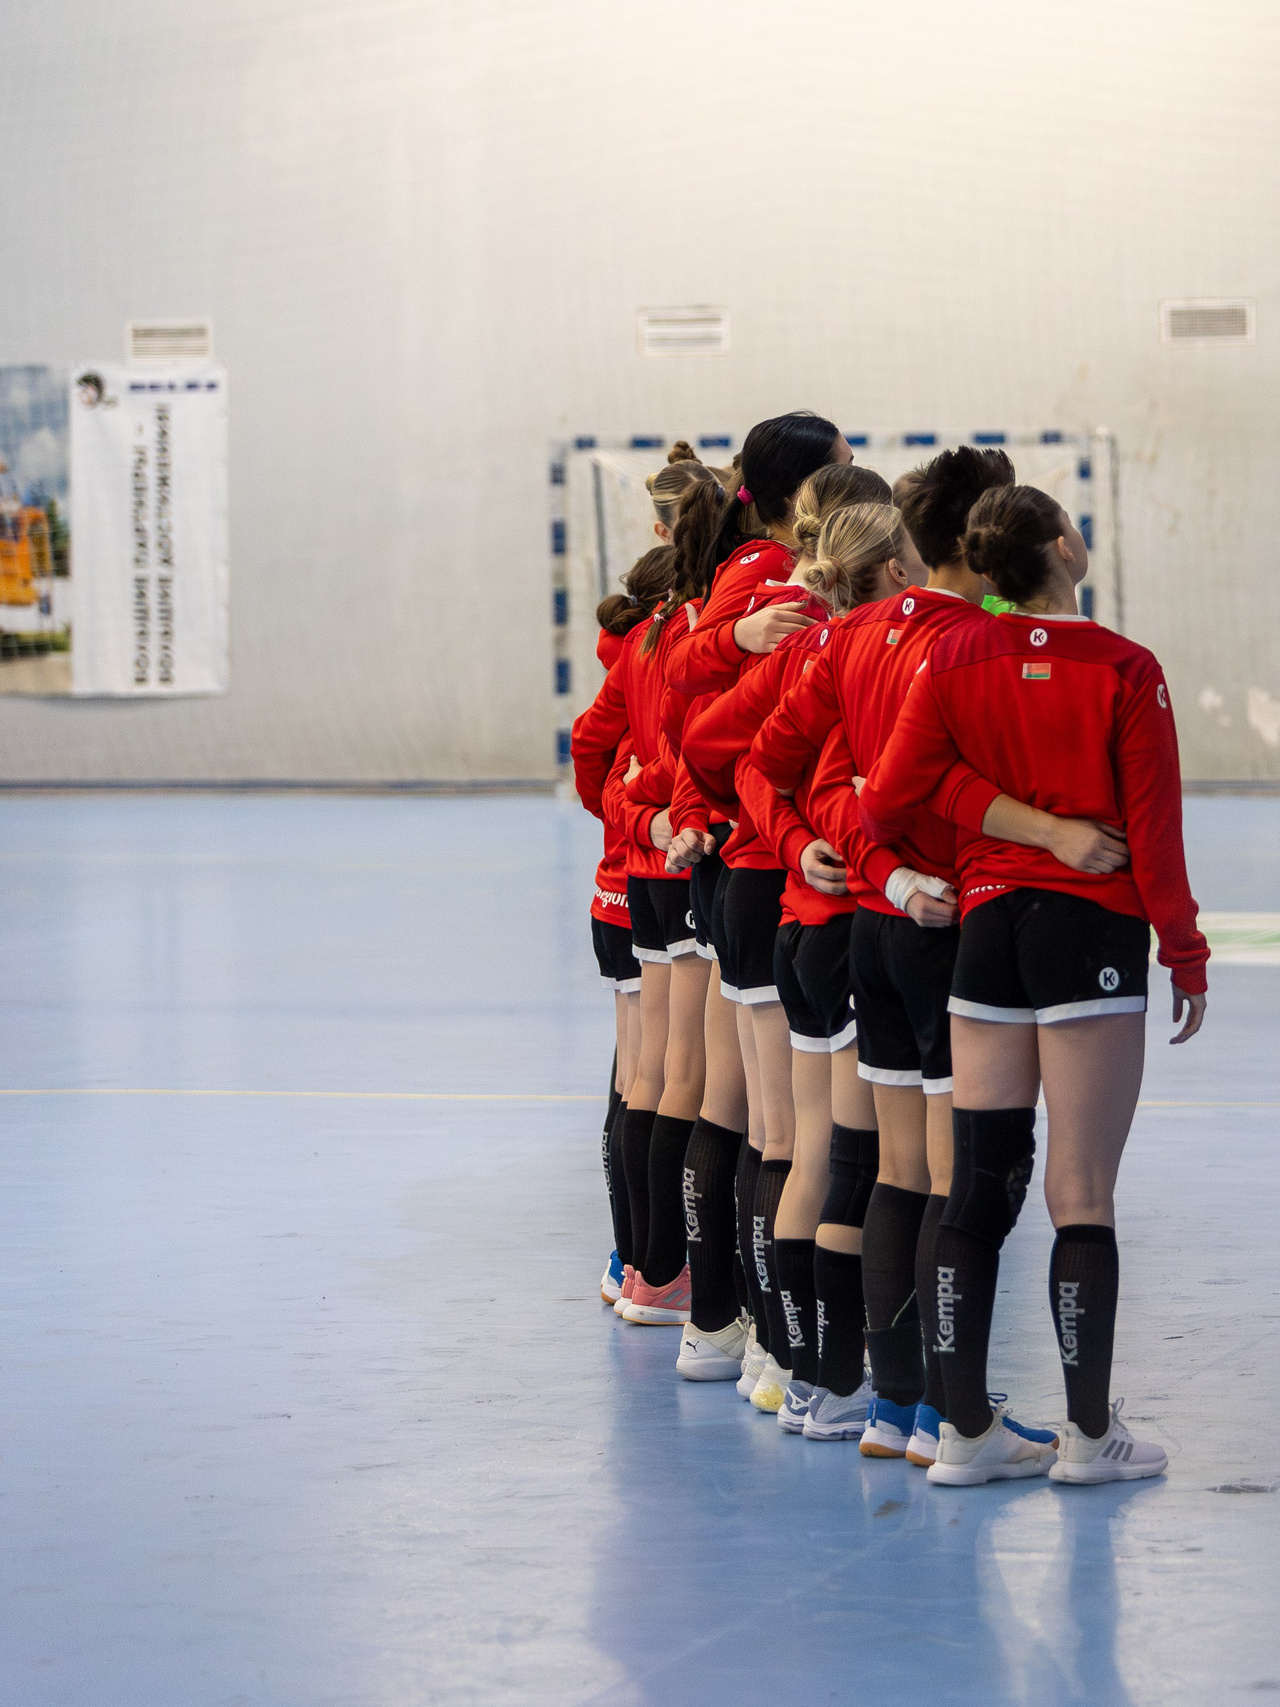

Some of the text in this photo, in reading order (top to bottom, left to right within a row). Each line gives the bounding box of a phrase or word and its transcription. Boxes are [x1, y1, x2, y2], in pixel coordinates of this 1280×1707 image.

[682, 1167, 702, 1242] Kempa
[753, 1215, 772, 1293] Kempa
[780, 1290, 806, 1347] Kempa
[933, 1266, 963, 1353] Kempa
[1059, 1281, 1085, 1367] Kempa
